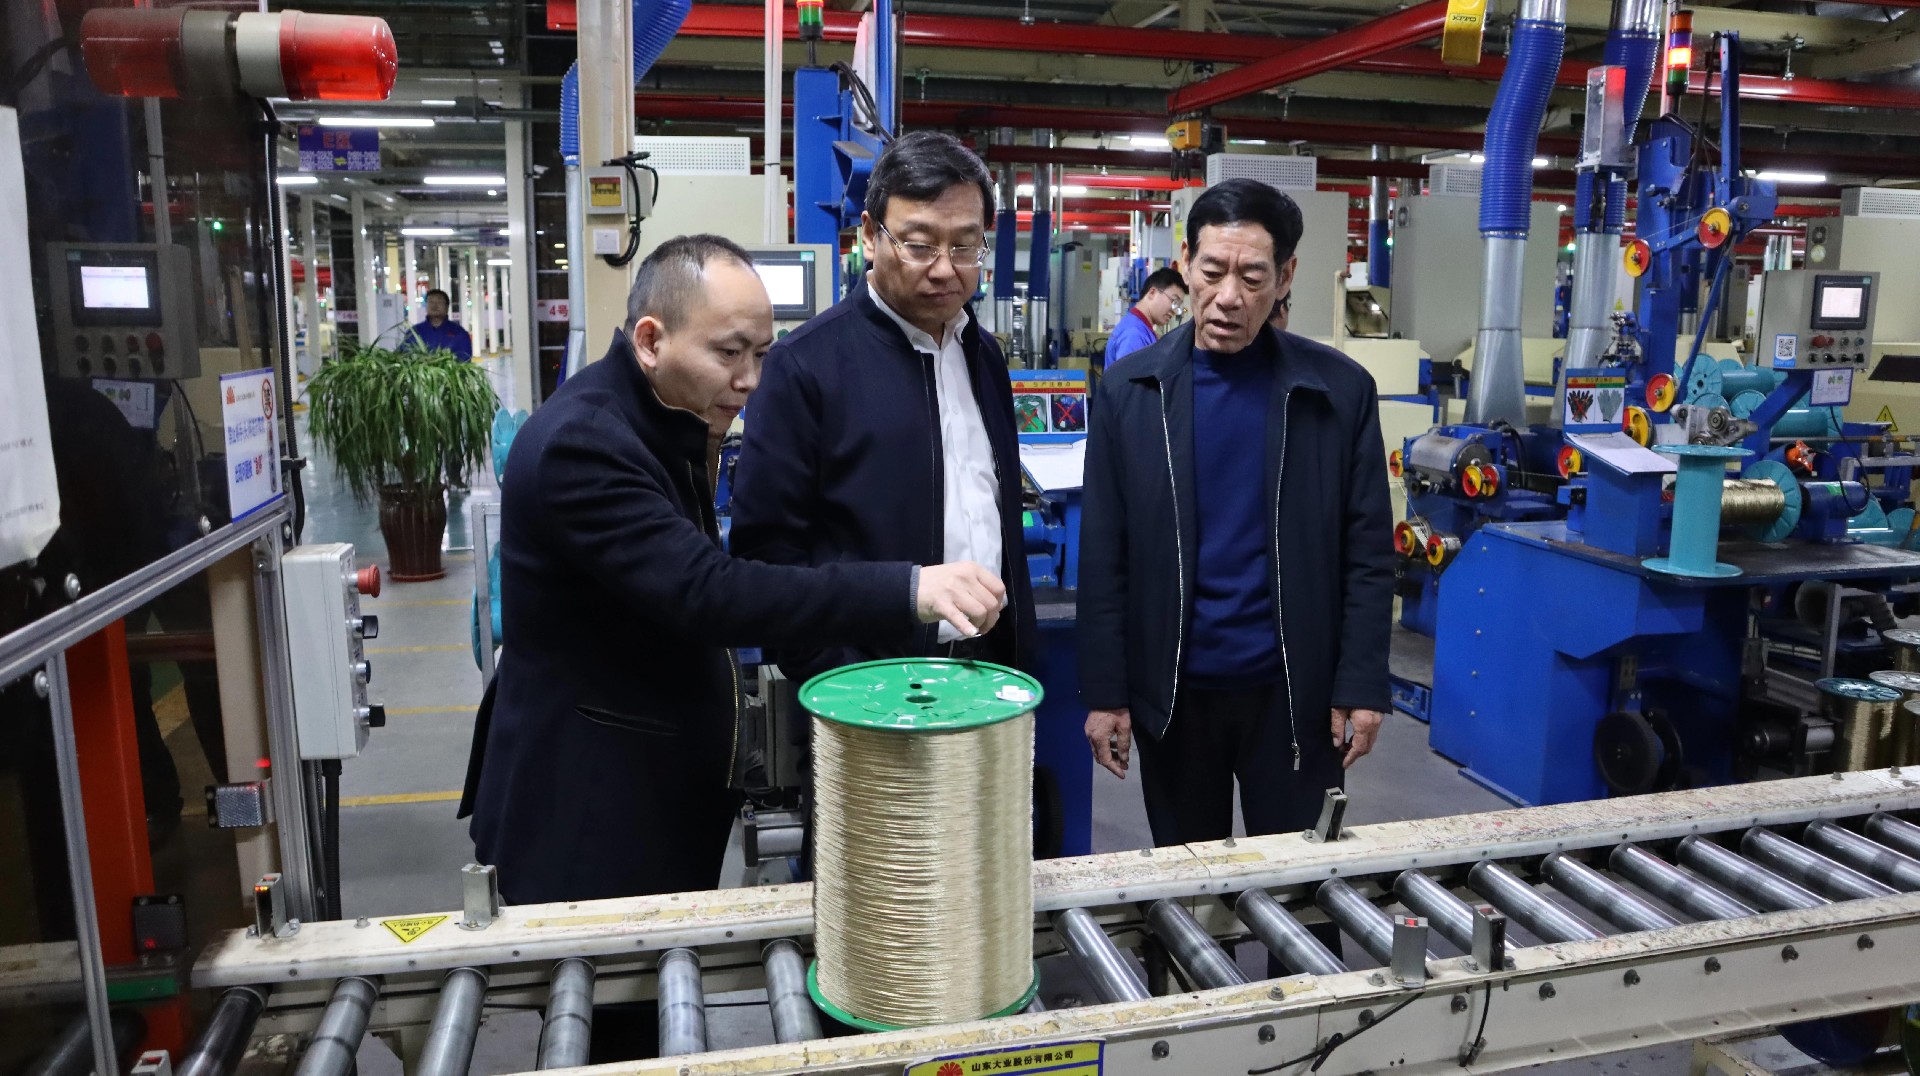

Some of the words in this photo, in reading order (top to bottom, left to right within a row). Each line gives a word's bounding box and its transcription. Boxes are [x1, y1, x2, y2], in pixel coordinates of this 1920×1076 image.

[549, 304, 568, 317] 4号
[971, 1050, 1074, 1072] 山东大业股份有限公司
